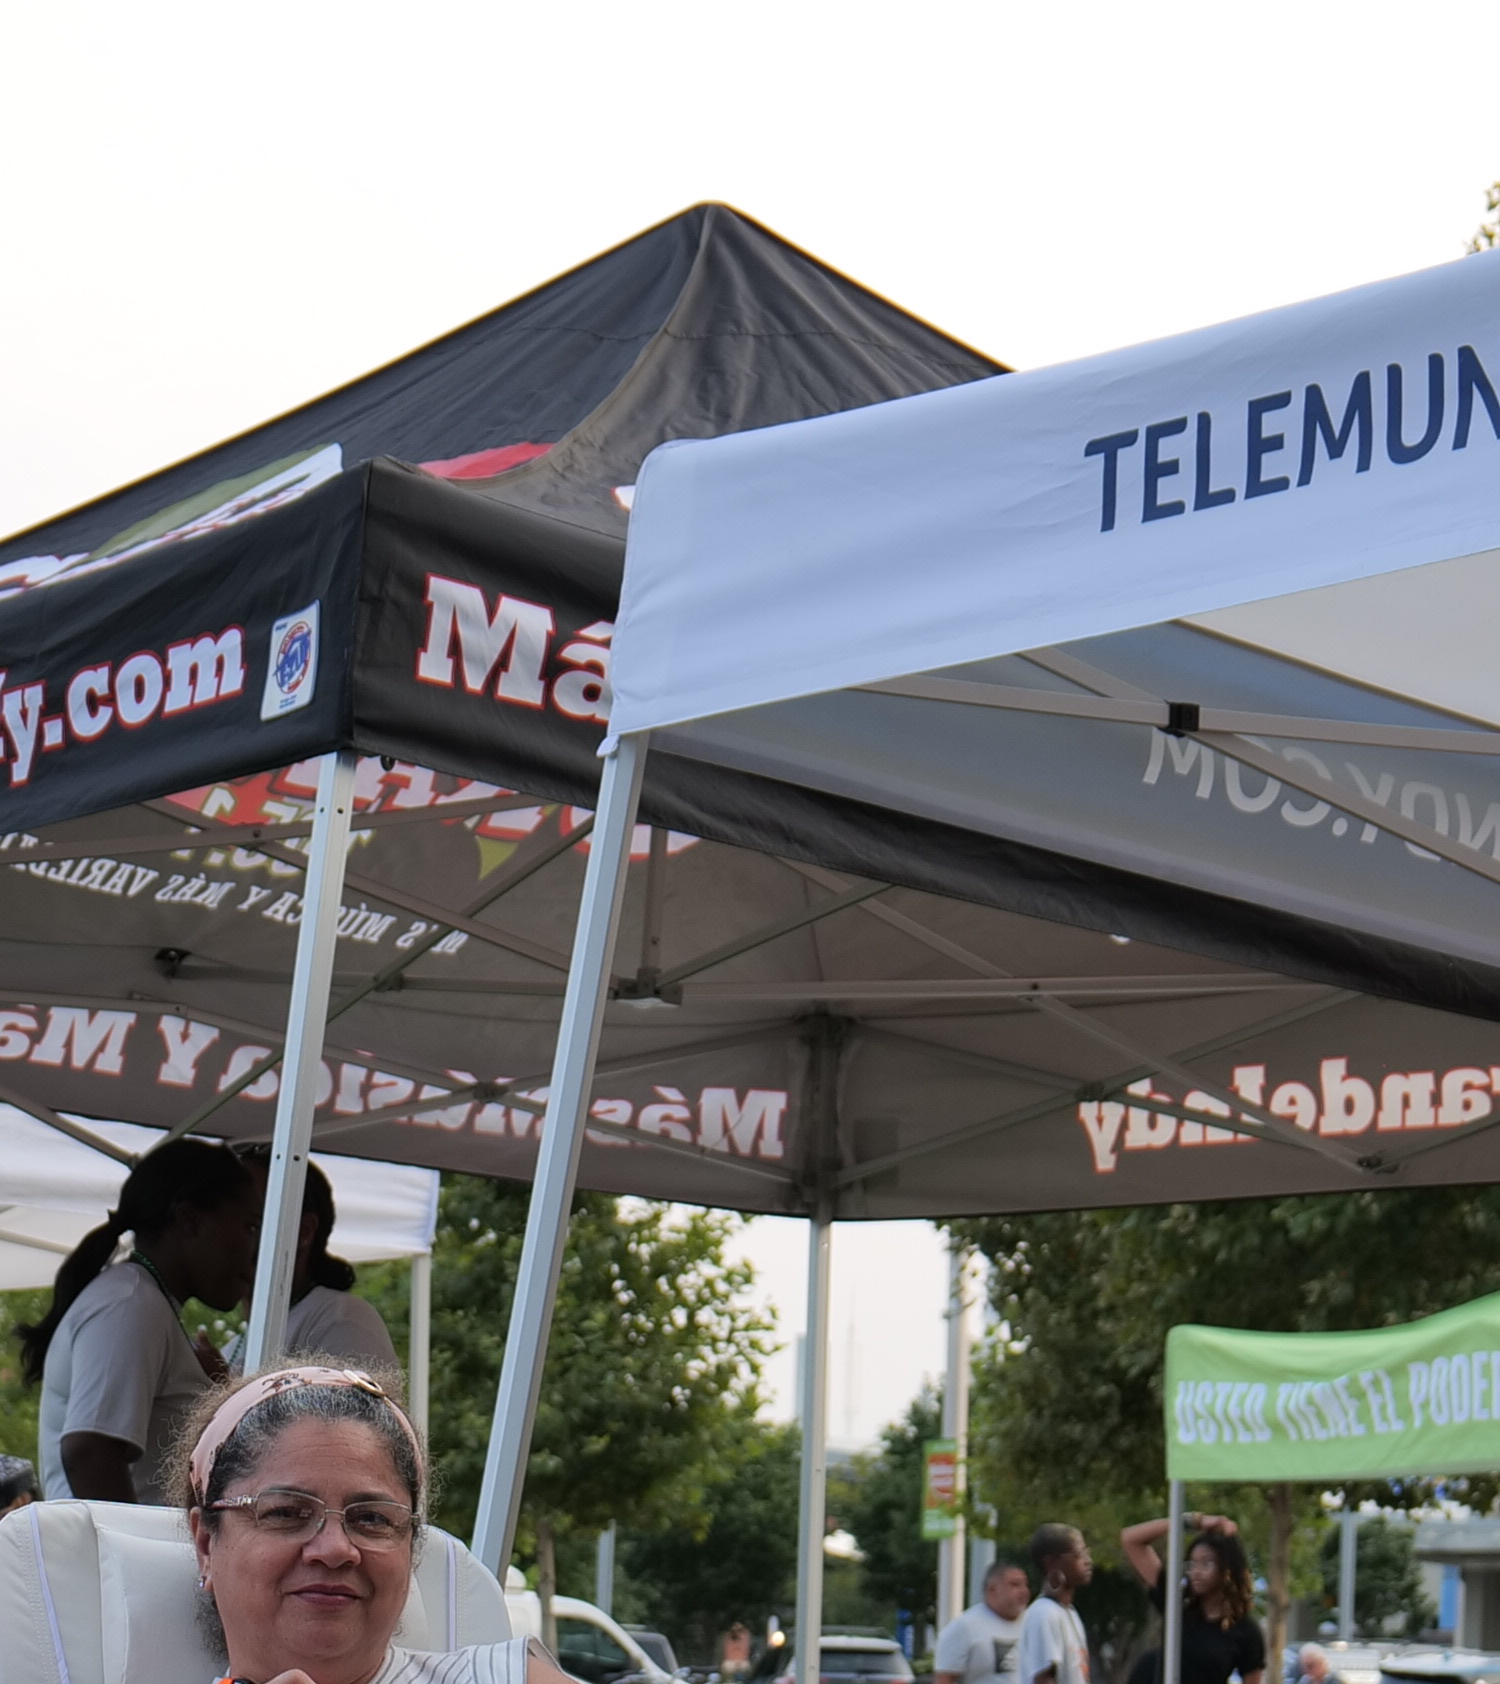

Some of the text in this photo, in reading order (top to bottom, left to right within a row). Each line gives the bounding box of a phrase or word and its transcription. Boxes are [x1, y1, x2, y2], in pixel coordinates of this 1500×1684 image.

[1176, 1380, 1272, 1445] USTED
[1276, 1374, 1367, 1442] TIENE
[1358, 1368, 1405, 1435] EL
